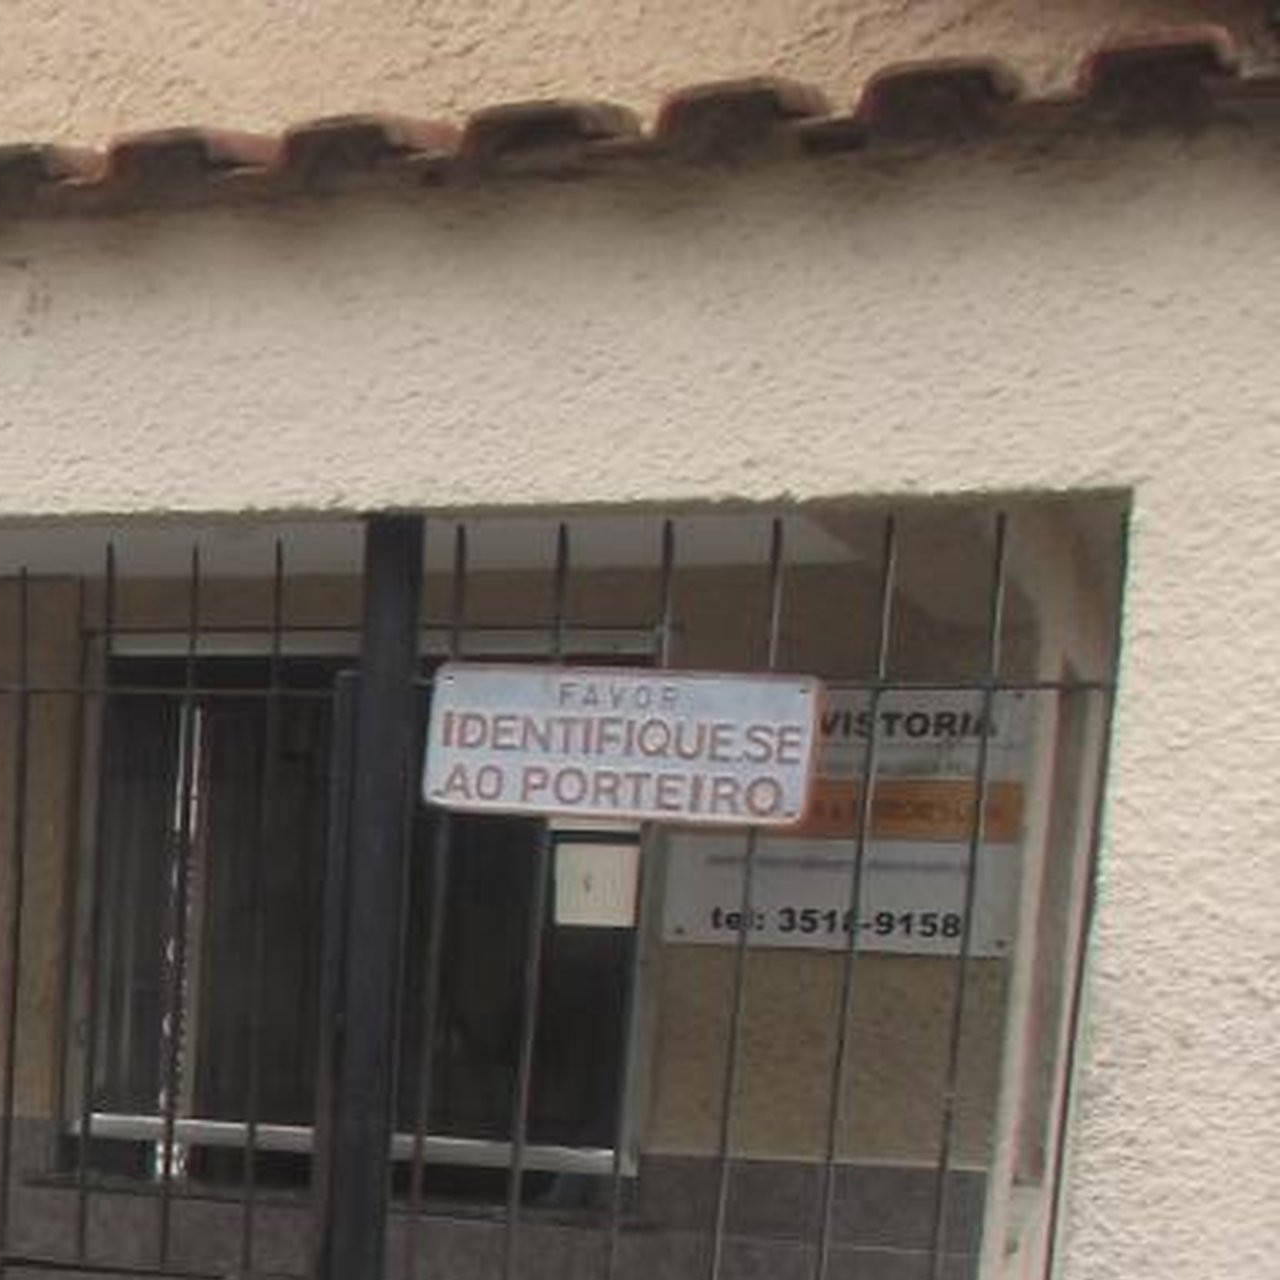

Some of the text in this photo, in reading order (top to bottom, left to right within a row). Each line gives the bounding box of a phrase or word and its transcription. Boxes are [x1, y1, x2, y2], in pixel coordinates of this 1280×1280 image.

[559, 683, 679, 709] FAVOR
[445, 763, 504, 801] AO
[523, 766, 783, 817] PORTEIRO
